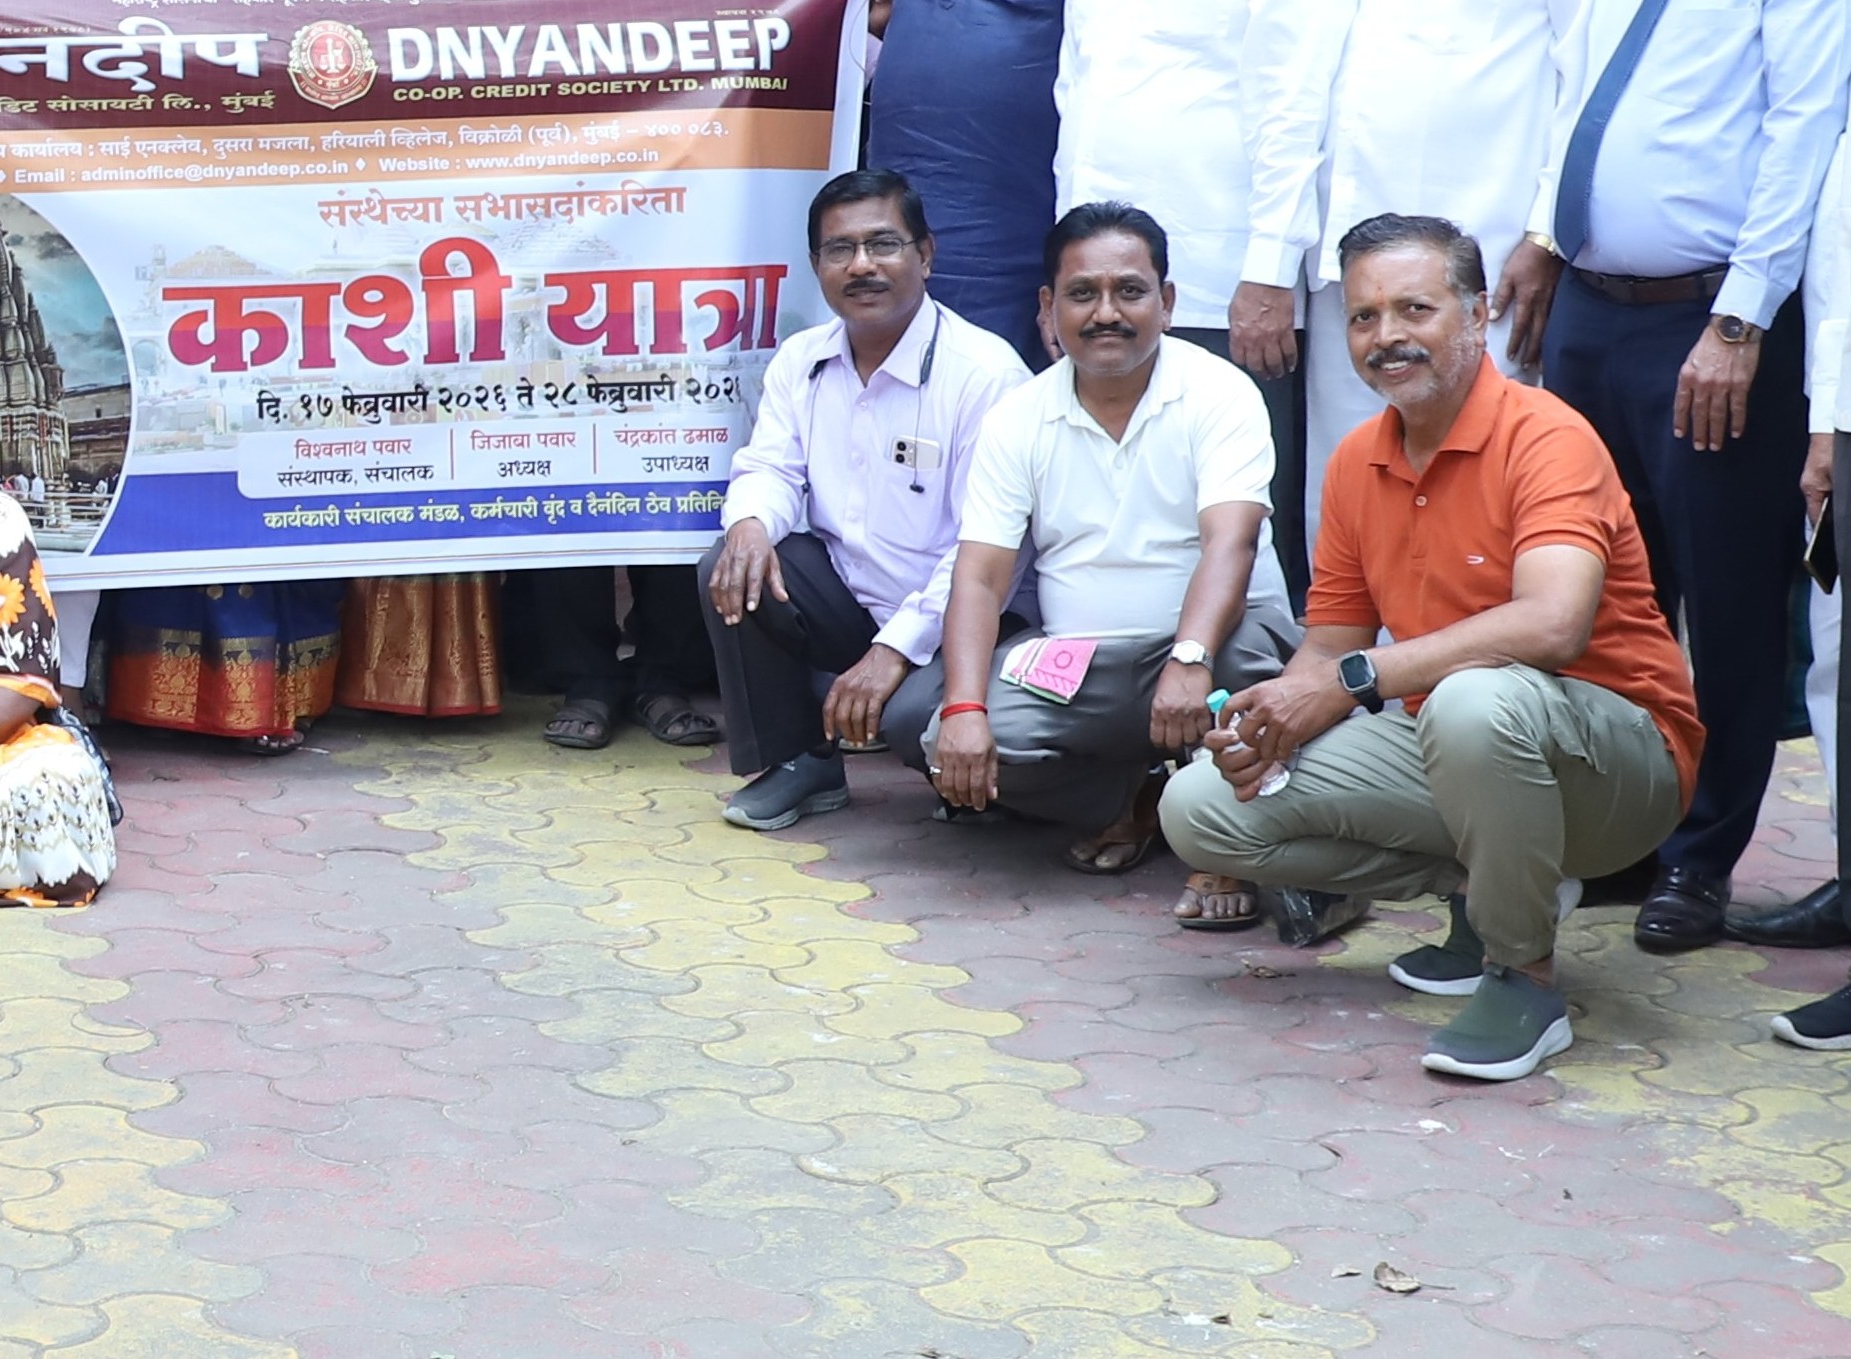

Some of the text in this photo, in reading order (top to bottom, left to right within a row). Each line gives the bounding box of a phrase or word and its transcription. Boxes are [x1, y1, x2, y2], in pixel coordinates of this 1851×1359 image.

[387, 15, 793, 83] DNYANDEEP
[47, 93, 155, 113] सोसायटी
[221, 89, 277, 111] मुंबई
[393, 76, 789, 102] CO-OP. CREDIT SOCIETY LTD. MUMBAI
[98, 135, 131, 157] साई
[135, 134, 207, 158] एनक्लेव,
[213, 137, 253, 160] दुसरा
[258, 136, 315, 153] मजला,
[321, 129, 386, 151] हरियाली
[391, 128, 453, 150] व्हिलेज,
[458, 124, 523, 146] विक्रोळी
[582, 121, 621, 145] मुंबई
[14, 168, 66, 184] Email
[80, 161, 349, 183] adminoffice@dnyandeep.co.in
[379, 157, 450, 173] Website
[465, 148, 660, 170] www.dnyandeep.co.in
[318, 179, 688, 228] संस्थेच्या सभासदांकरिता
[162, 236, 789, 373] काशी यात्रा
[256, 390, 288, 425] दि.
[300, 393, 334, 420] १७
[341, 384, 430, 424] फेब्रुवारी
[438, 383, 508, 413] २०२६
[516, 377, 535, 409] ते
[544, 382, 578, 409] २८
[586, 373, 677, 413] फेब्रुवारी
[294, 438, 413, 459] विश्वनाथ पवार
[536, 431, 577, 448] पवार
[613, 423, 729, 448] चंद्रकांत ढमाळ
[277, 460, 435, 488] संस्थापक, संचालक
[497, 460, 552, 478] अध्यक्ष
[641, 455, 710, 474] उपाध्यक्ष
[263, 504, 340, 529] कार्यकारी
[344, 501, 415, 526] संचालक
[418, 498, 466, 523] मंडळ,
[469, 494, 539, 520] कर्मचारी
[569, 499, 583, 515] व
[586, 491, 641, 517] दैनंदिन
[645, 491, 672, 514] ठेव
[676, 489, 725, 514] प्रतिनि
